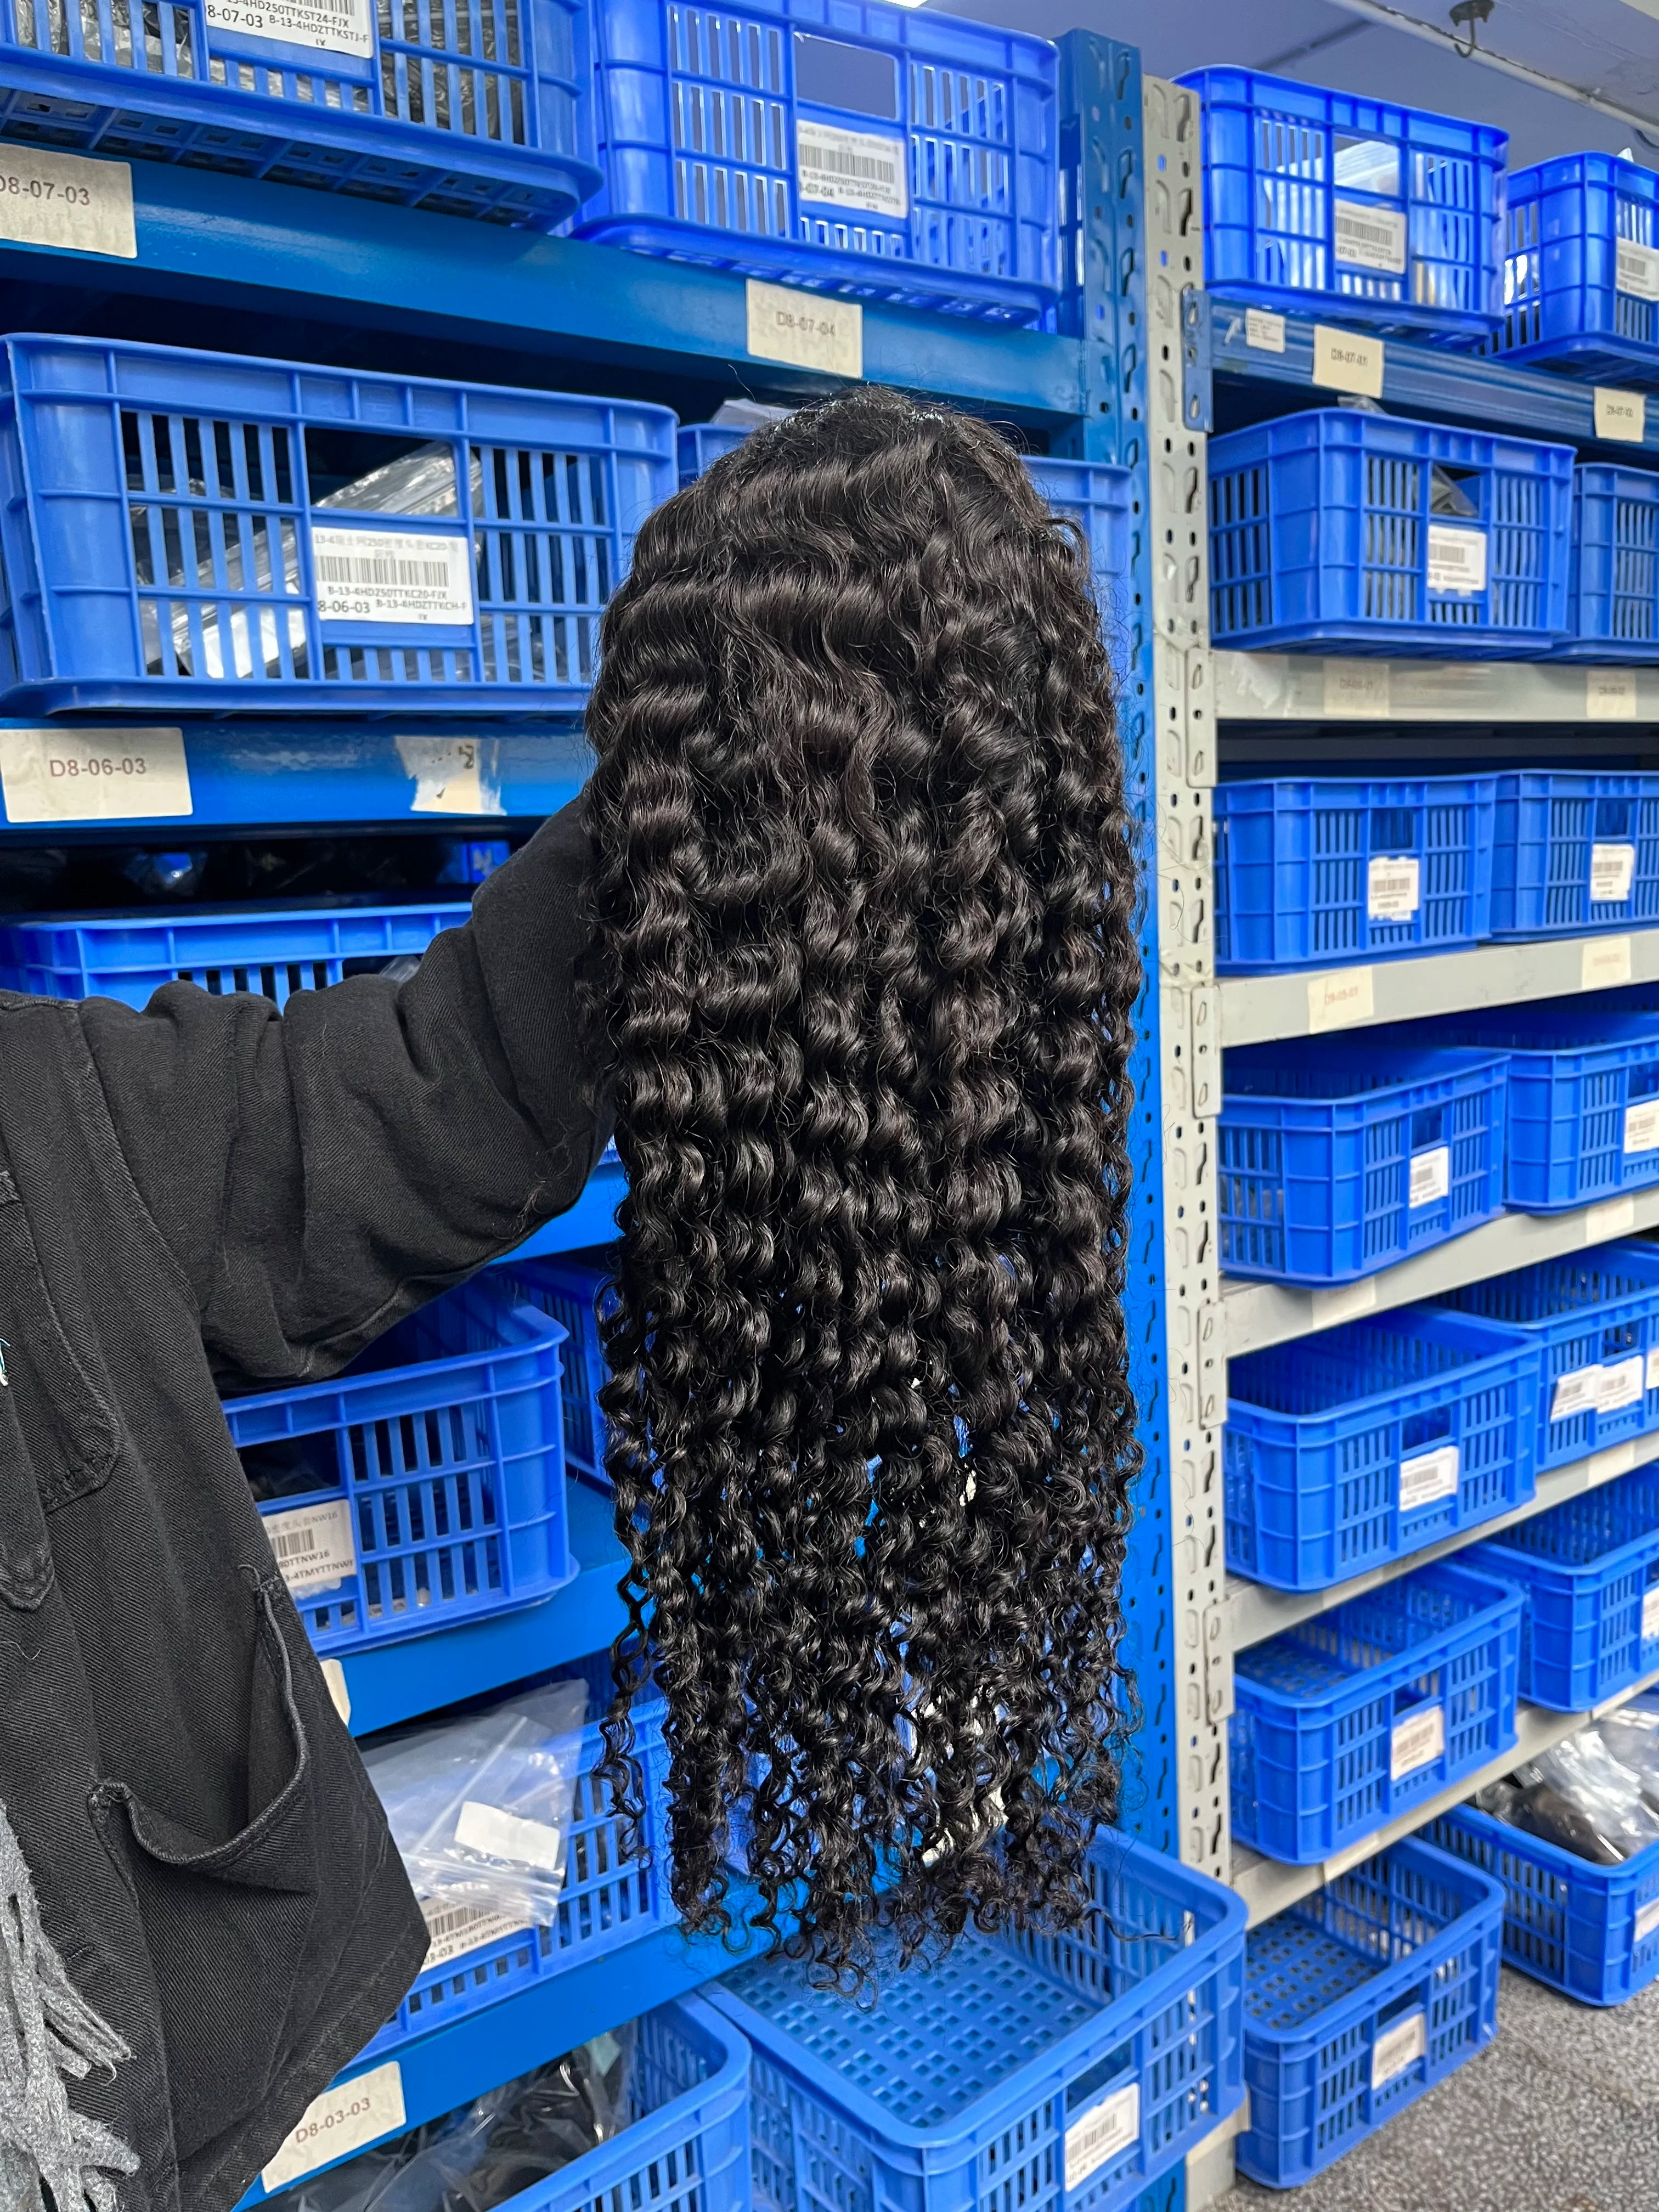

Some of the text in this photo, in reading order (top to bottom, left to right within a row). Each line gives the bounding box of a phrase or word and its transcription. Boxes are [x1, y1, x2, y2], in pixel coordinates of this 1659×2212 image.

[776, 311, 836, 337] D8-07-04
[318, 600, 370, 613] 8-06-03
[50, 758, 146, 777] D8-06-03
[296, 2097, 371, 2143] D8-03-03
